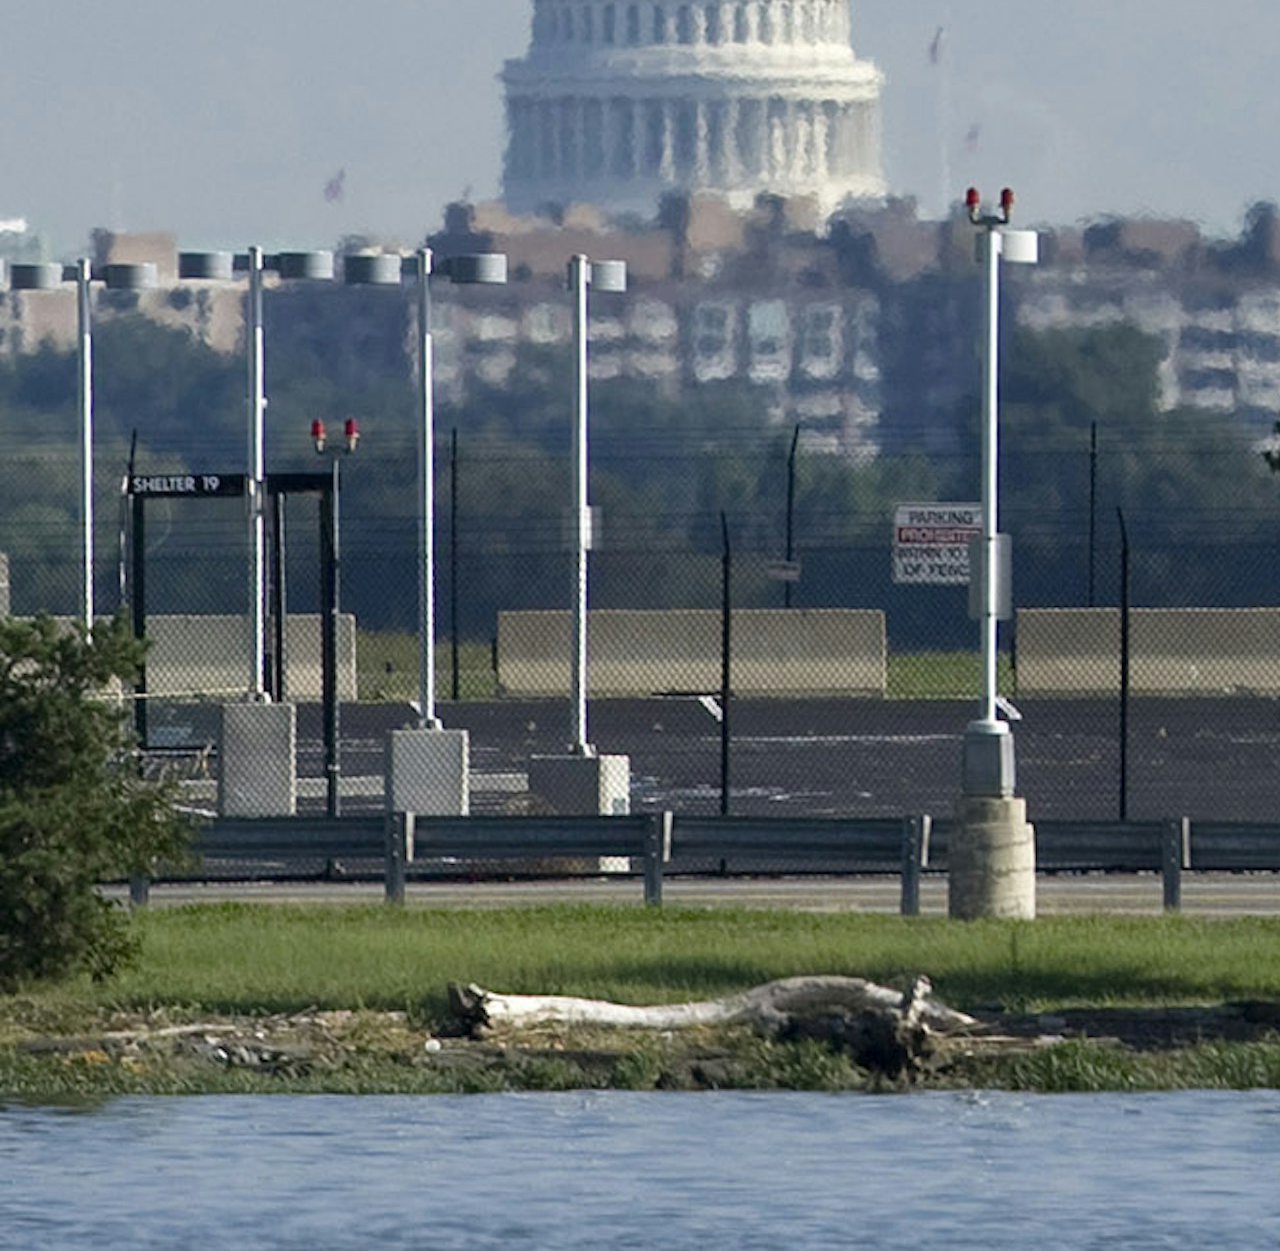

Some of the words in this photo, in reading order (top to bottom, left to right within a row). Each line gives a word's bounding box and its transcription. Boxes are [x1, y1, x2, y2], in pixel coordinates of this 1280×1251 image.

[132, 476, 196, 493] SHELTER
[202, 476, 221, 491] 19
[908, 510, 974, 525] PARKING
